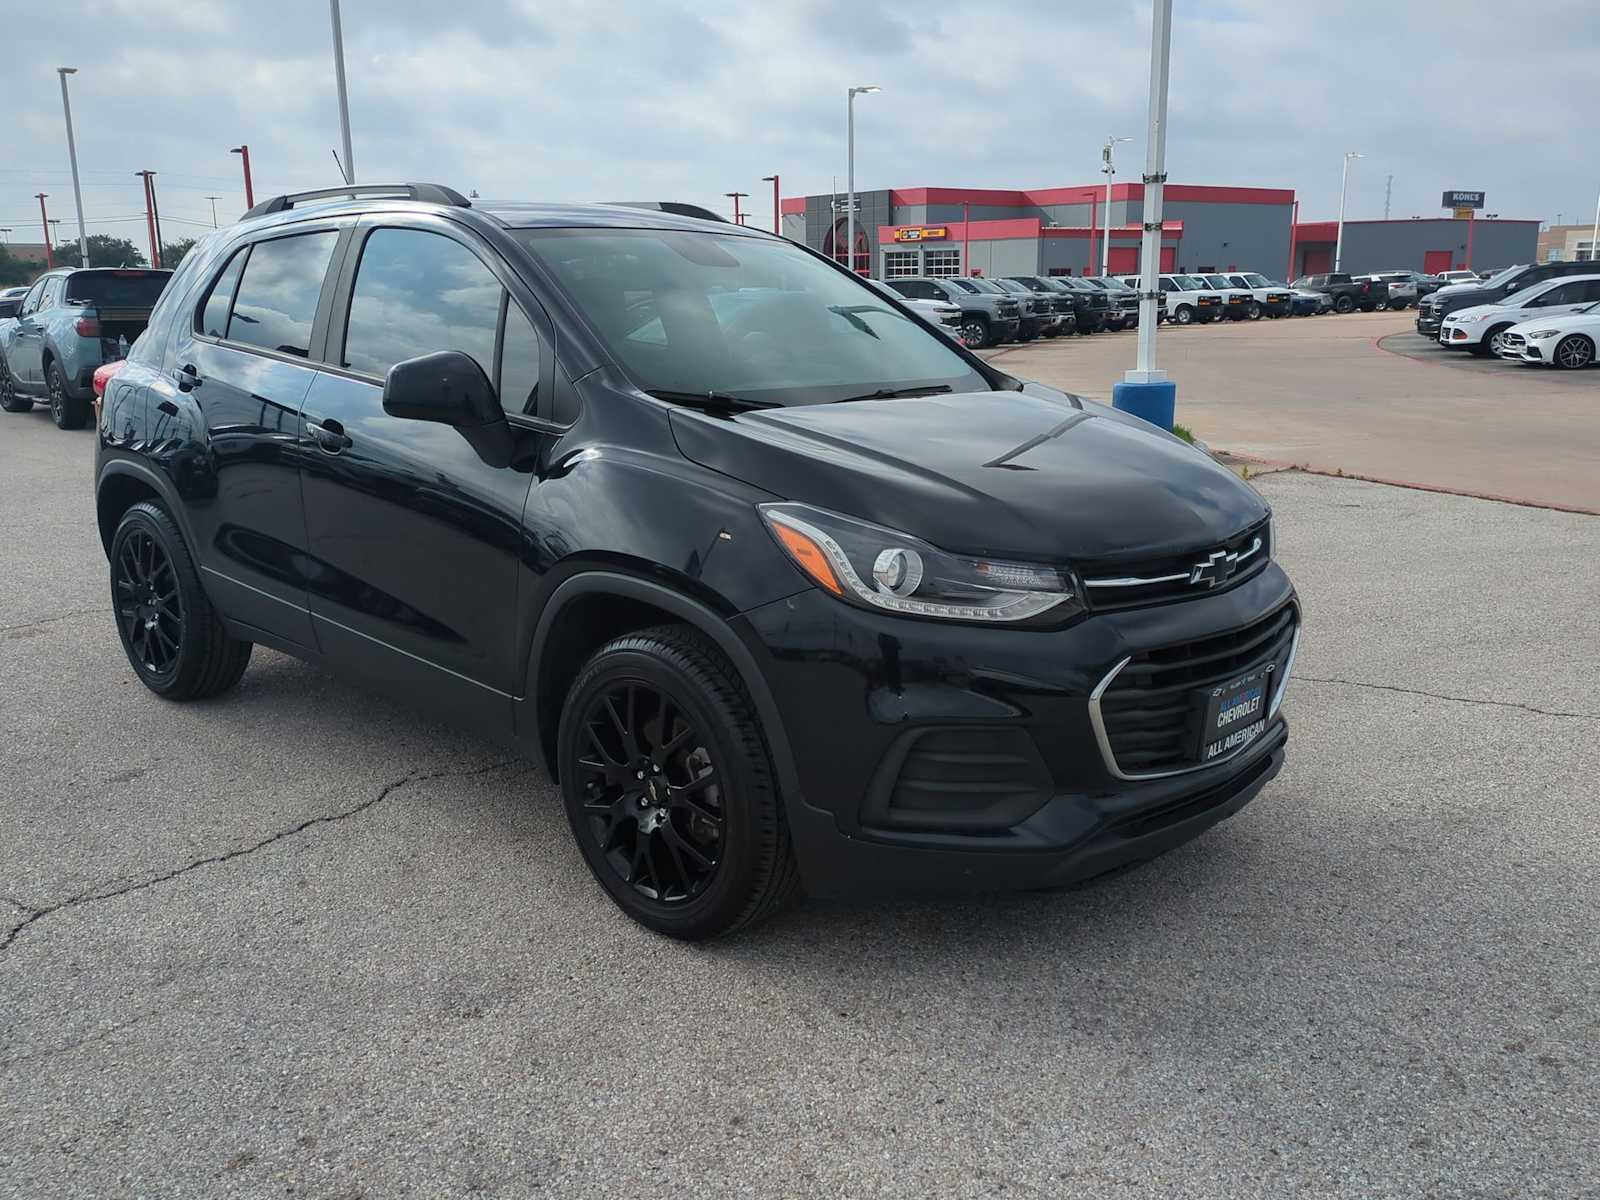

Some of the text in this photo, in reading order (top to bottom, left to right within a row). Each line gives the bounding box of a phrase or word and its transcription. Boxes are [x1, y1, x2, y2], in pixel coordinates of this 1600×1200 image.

[1217, 695, 1261, 728] CHEVROLET
[1207, 719, 1265, 759] ALL AMERICAN
